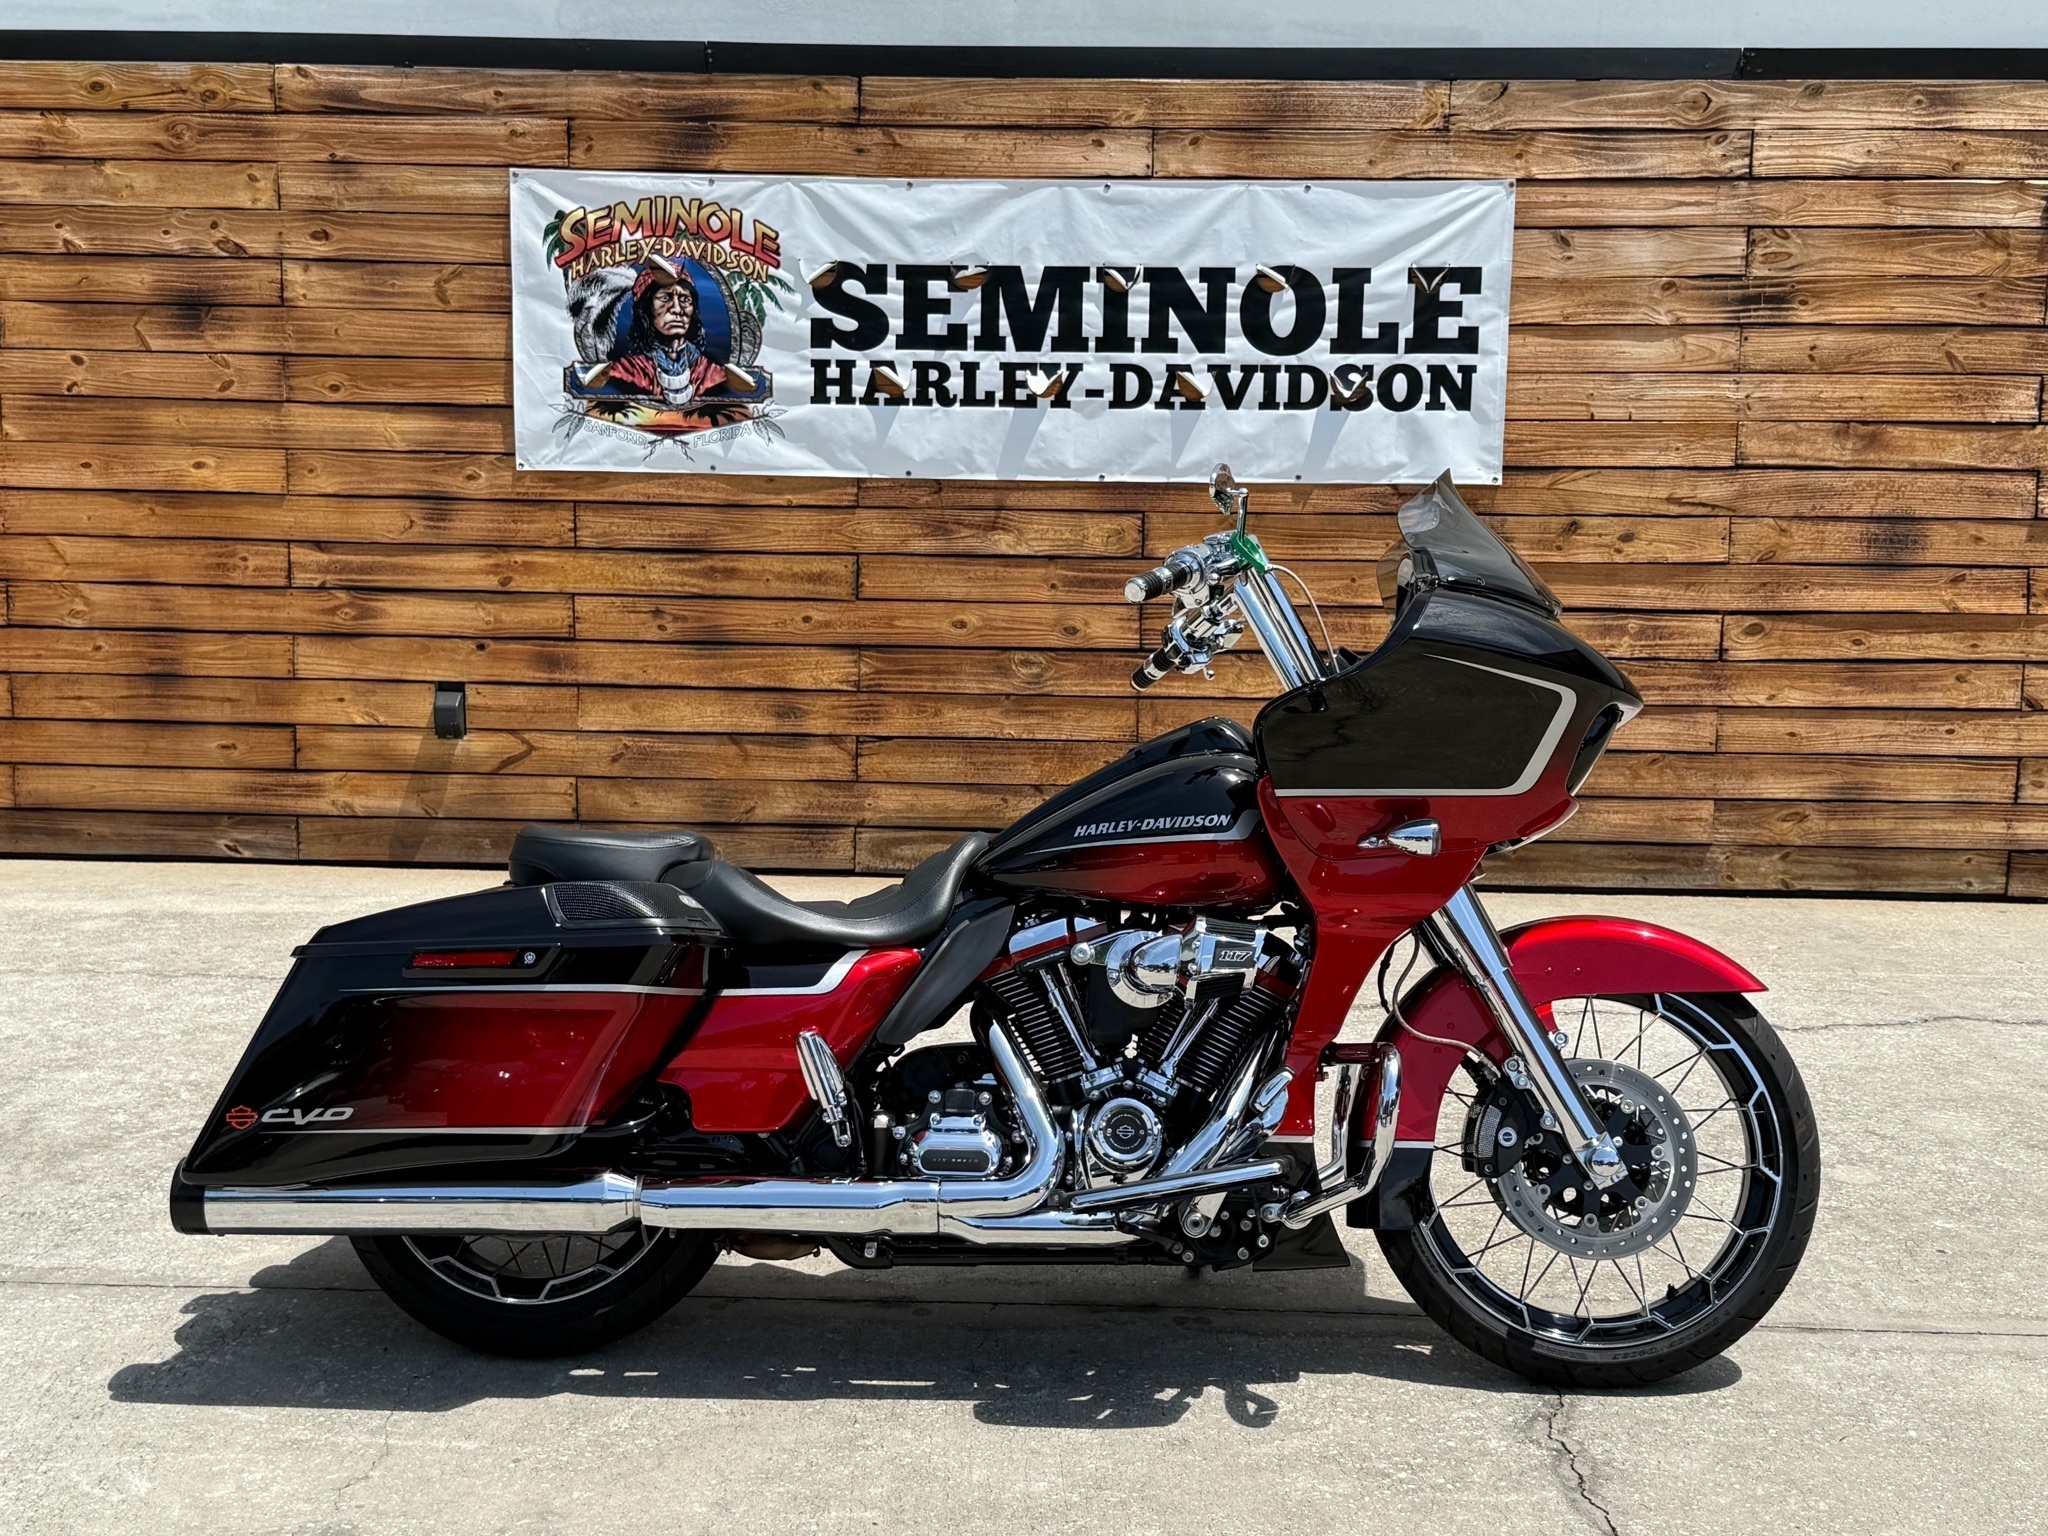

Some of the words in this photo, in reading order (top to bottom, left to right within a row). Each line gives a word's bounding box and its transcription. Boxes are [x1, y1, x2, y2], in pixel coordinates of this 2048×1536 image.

[554, 196, 780, 268] SEMINOLE
[571, 237, 769, 282] HARLEY-DAVIDSON
[810, 261, 1483, 357] SEMINOLE
[810, 359, 1477, 412] HARLEY-DAVIDSON
[693, 425, 751, 448] FLORIDA
[1073, 814, 1231, 837] HARLEY-DAVIDSON
[1218, 950, 1252, 962] 117
[261, 1107, 354, 1125] CVO
